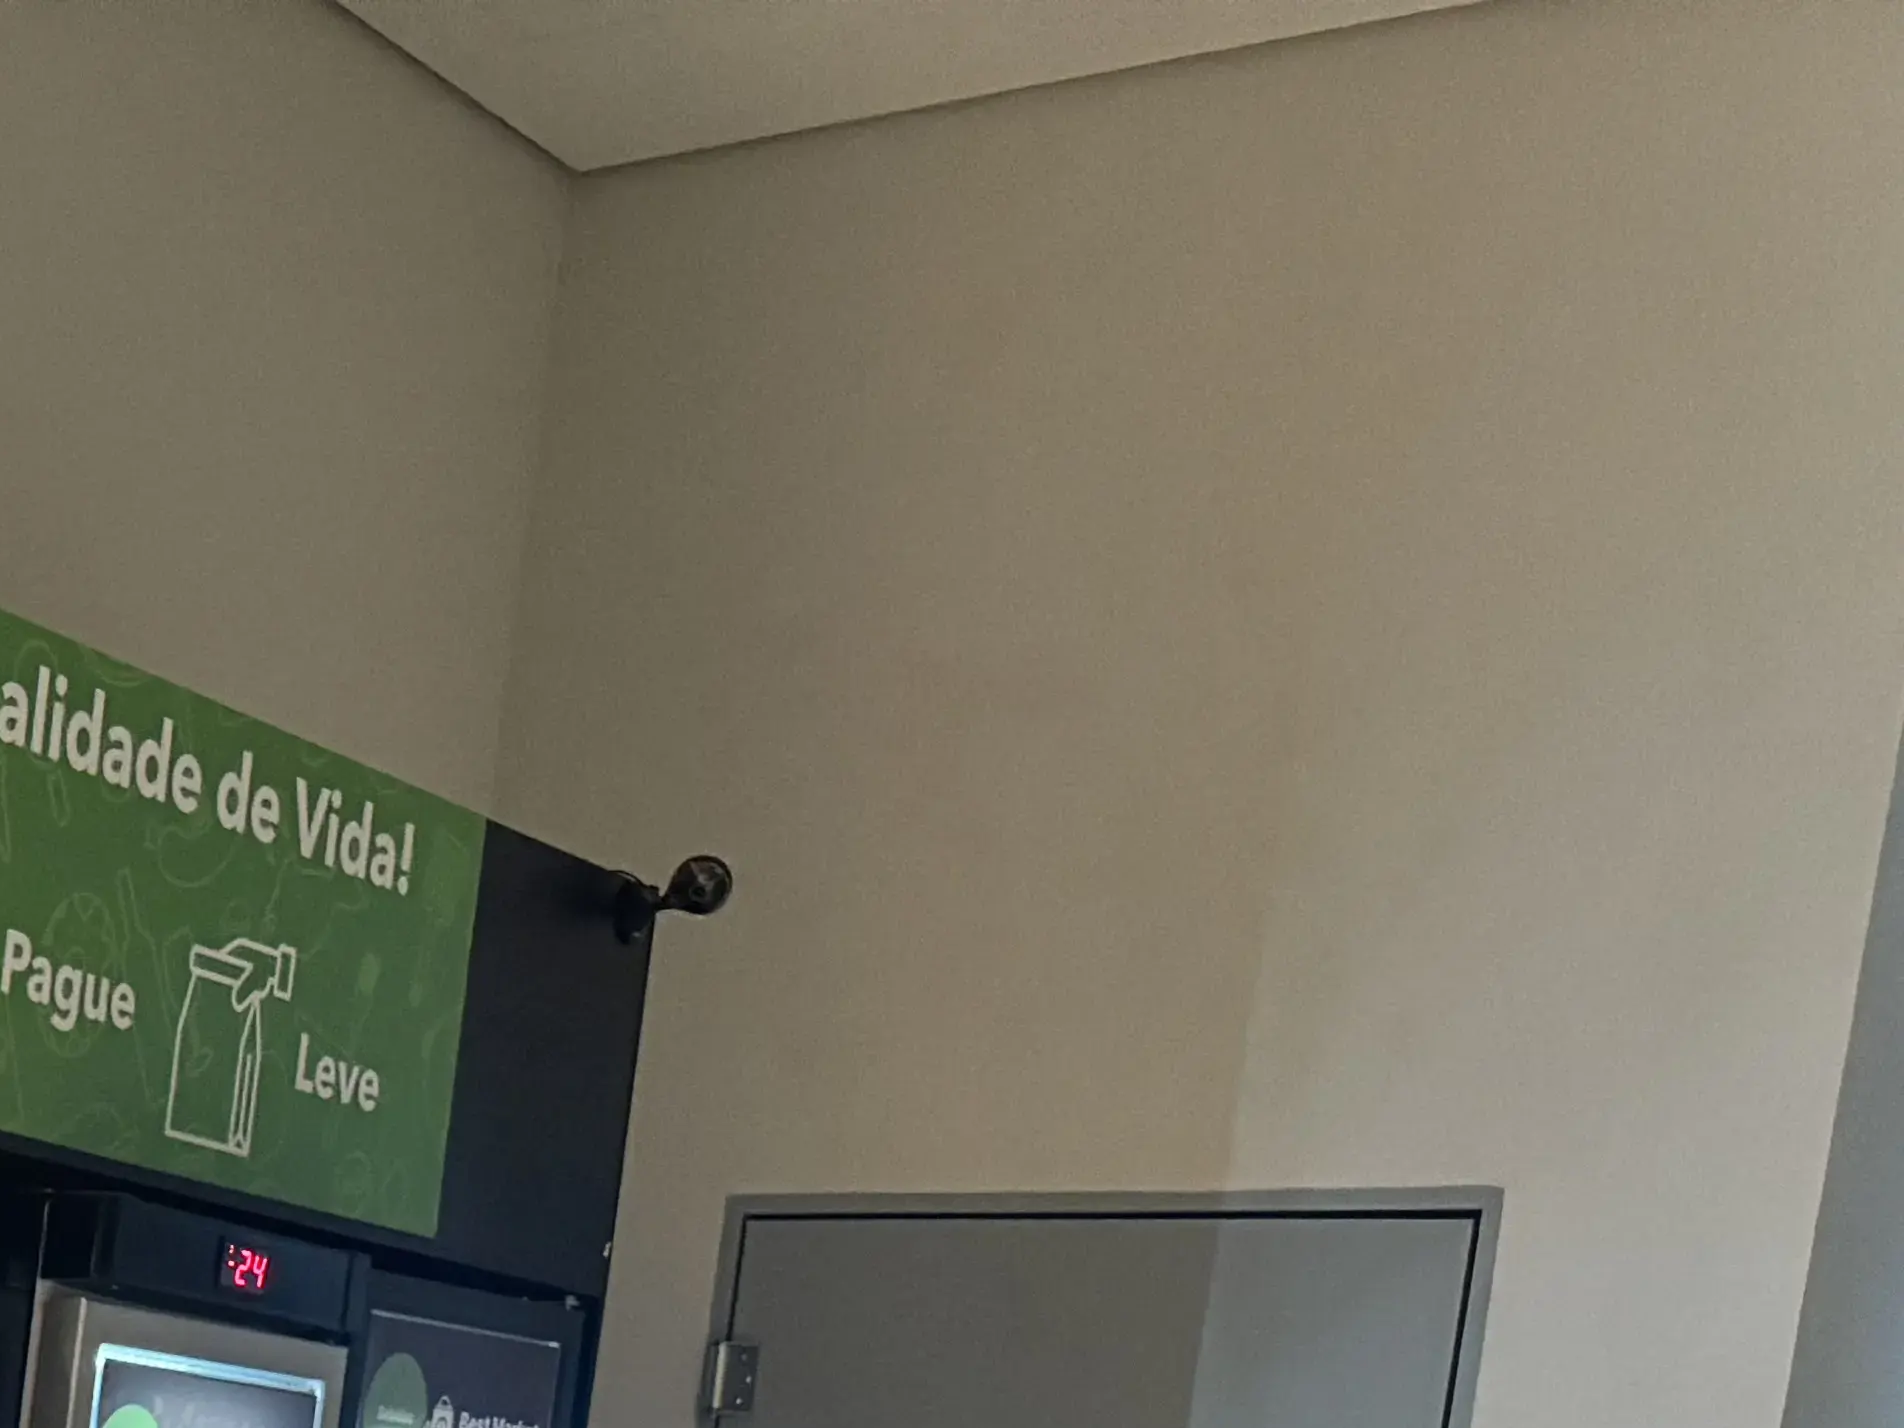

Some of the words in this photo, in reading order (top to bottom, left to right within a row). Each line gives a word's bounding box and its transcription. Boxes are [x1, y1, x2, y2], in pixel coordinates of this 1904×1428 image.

[215, 749, 282, 845] de
[294, 776, 419, 898] Vida!
[0, 928, 138, 1033] Pague
[294, 1031, 381, 1115] Leve
